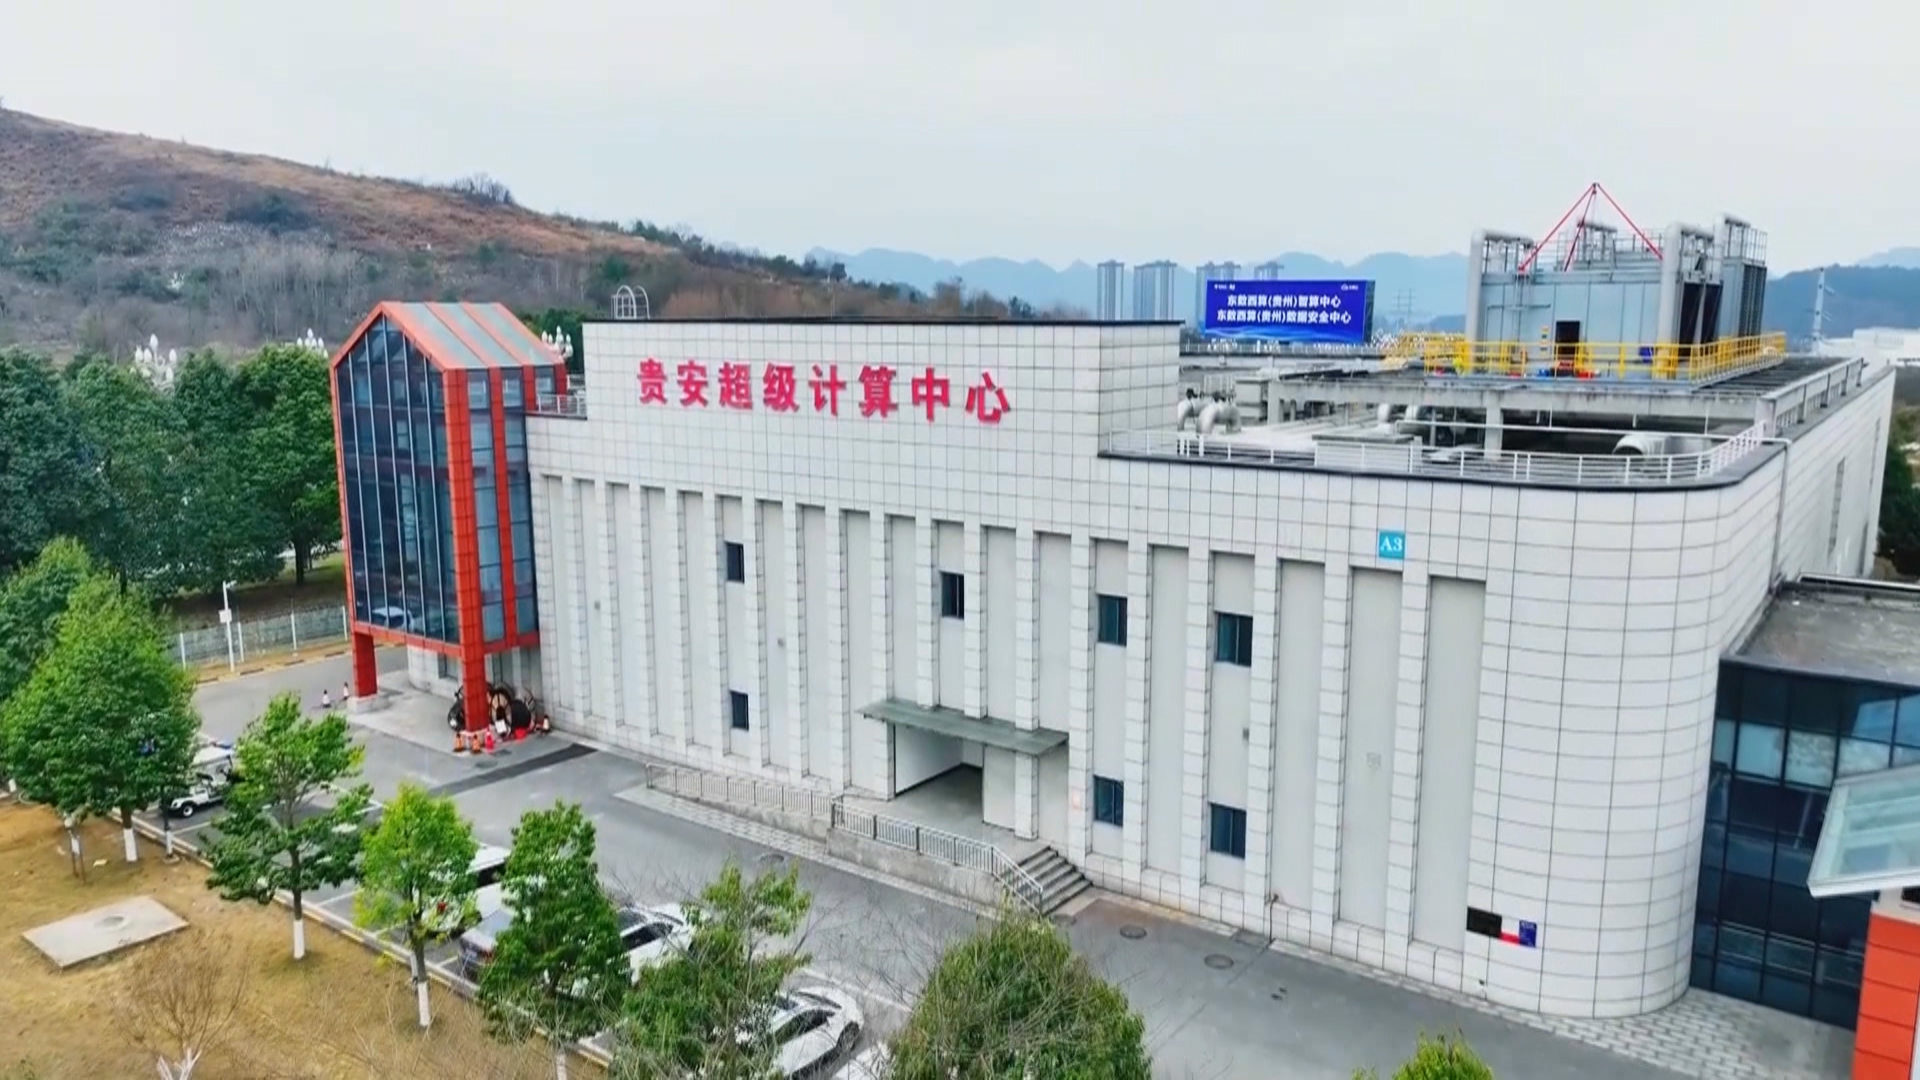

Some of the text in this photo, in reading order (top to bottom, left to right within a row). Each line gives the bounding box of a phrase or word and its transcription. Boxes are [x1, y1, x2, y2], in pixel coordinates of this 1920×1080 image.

[636, 357, 1012, 425] 贵安超级计算中心
[1379, 535, 1403, 552] A3
